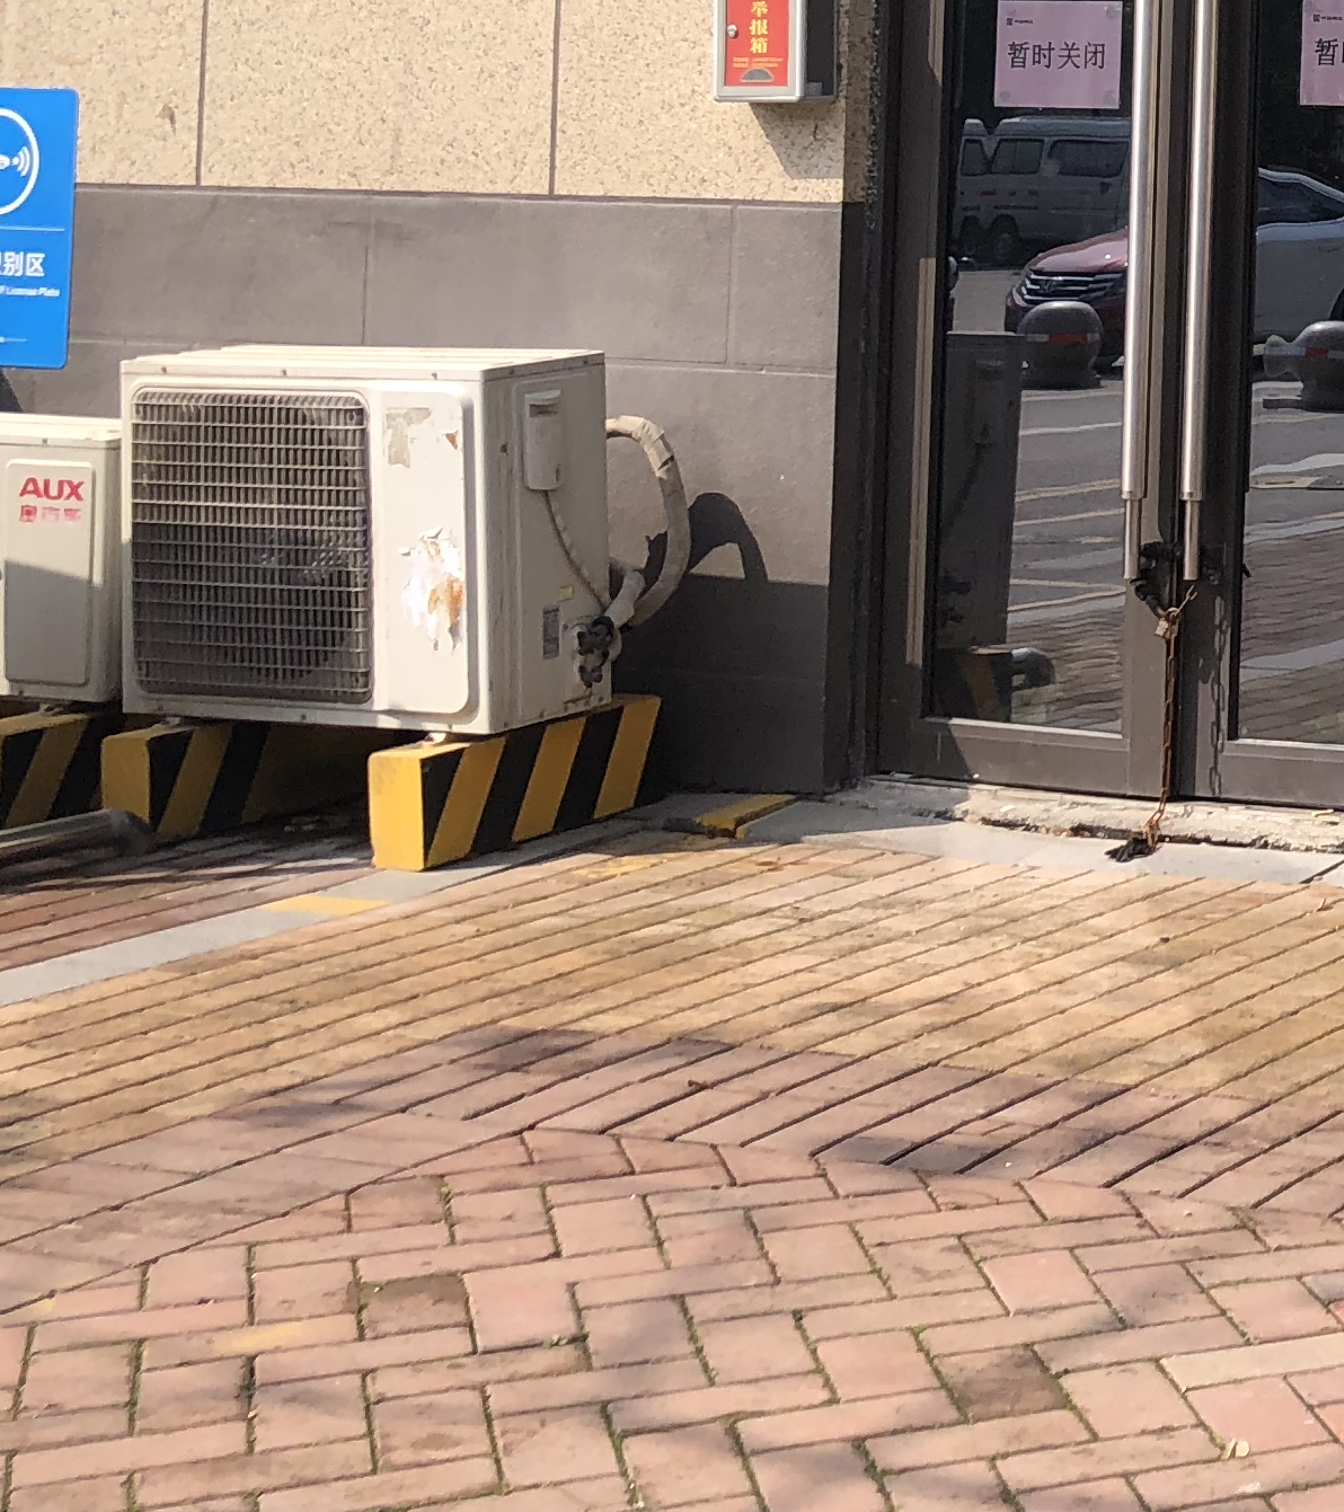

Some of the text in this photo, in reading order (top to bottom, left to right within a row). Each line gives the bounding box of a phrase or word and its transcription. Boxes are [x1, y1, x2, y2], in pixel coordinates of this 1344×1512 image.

[749, 0, 769, 54] 举报箱
[1008, 40, 1106, 70] 暂时关闭
[0, 251, 46, 277] 别区
[19, 477, 84, 501] AUX
